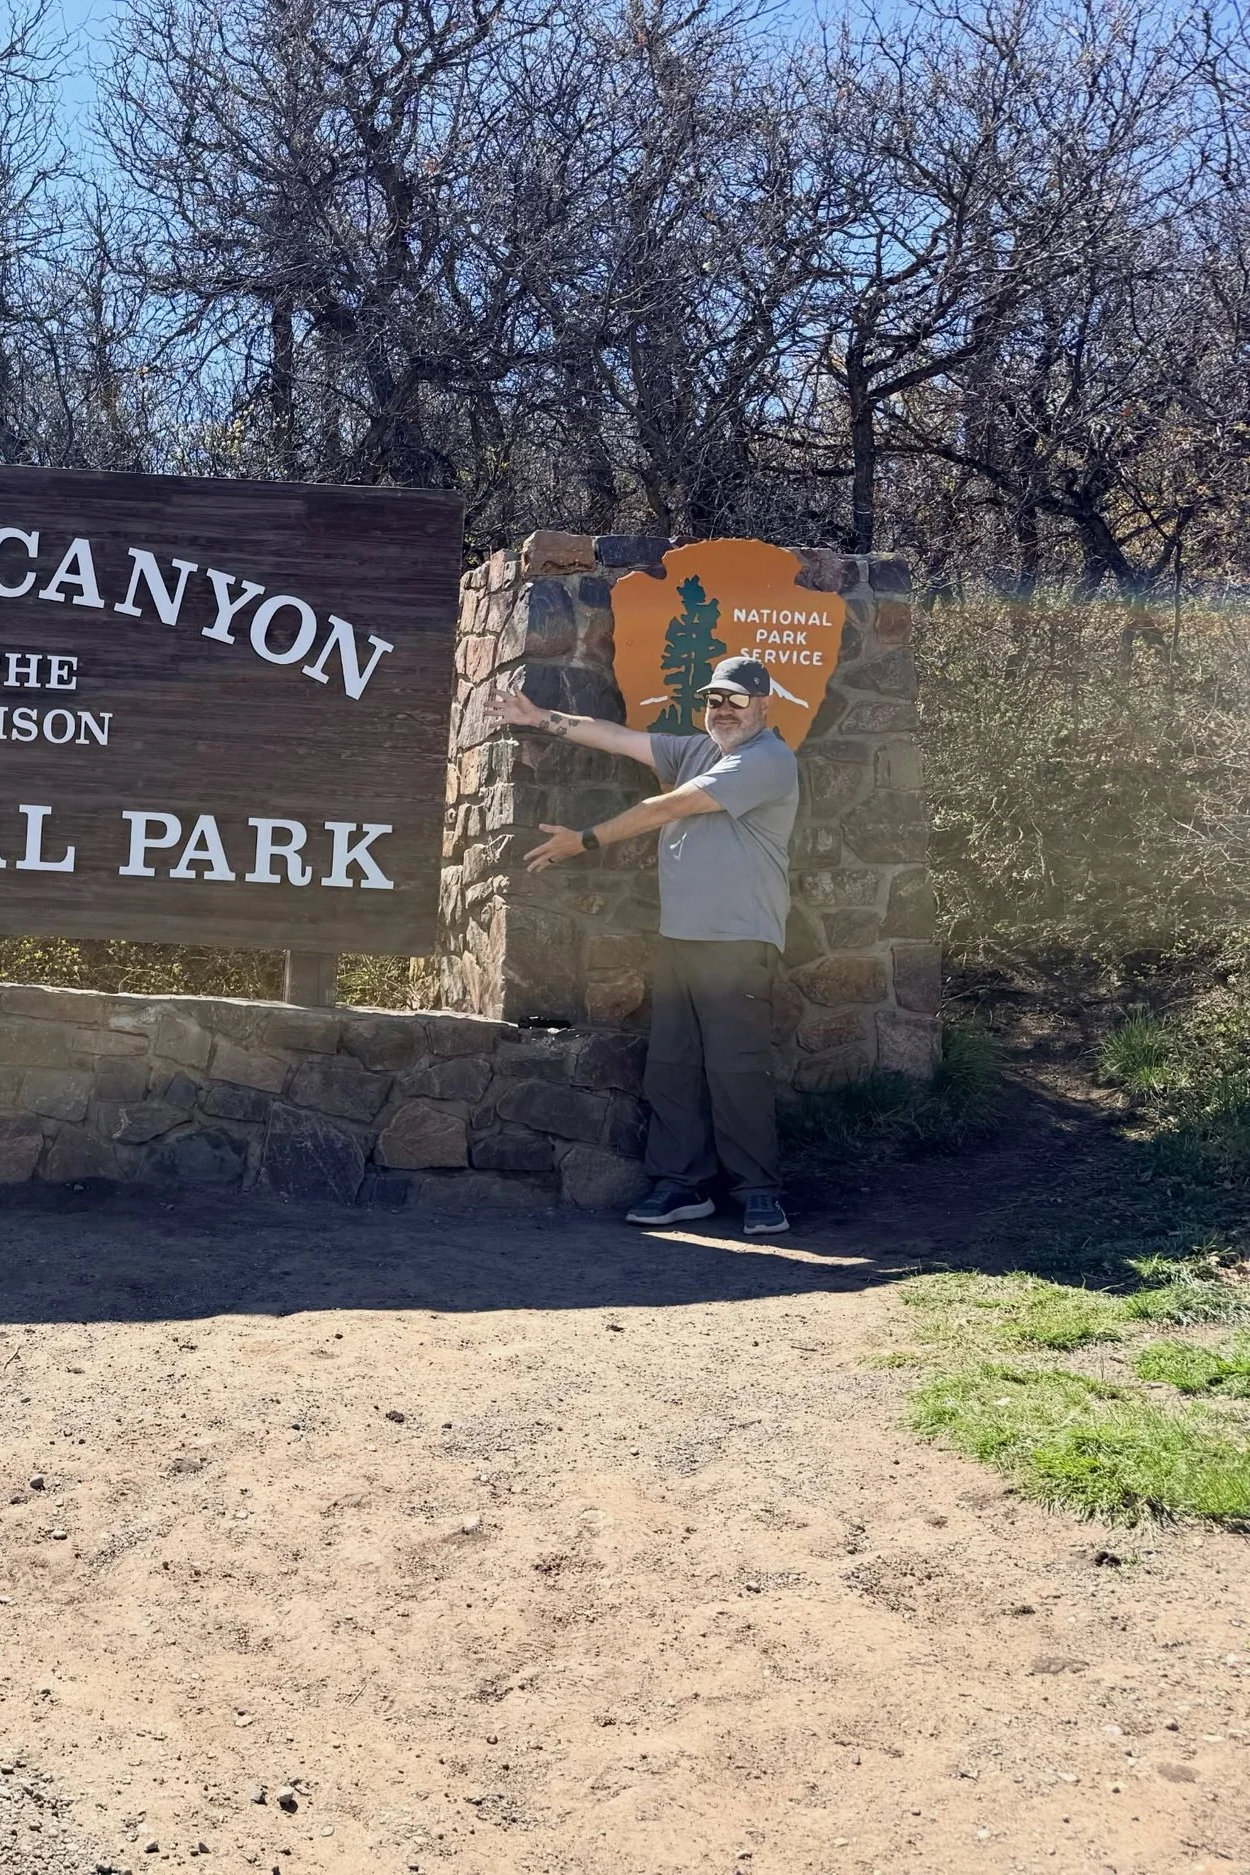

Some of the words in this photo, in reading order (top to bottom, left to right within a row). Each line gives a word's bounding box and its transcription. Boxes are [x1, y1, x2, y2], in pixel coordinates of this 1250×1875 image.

[733, 608, 833, 627] NATIONAL
[755, 628, 807, 645] PARK
[740, 647, 823, 666] SERVICE
[118, 810, 395, 890] PARK
